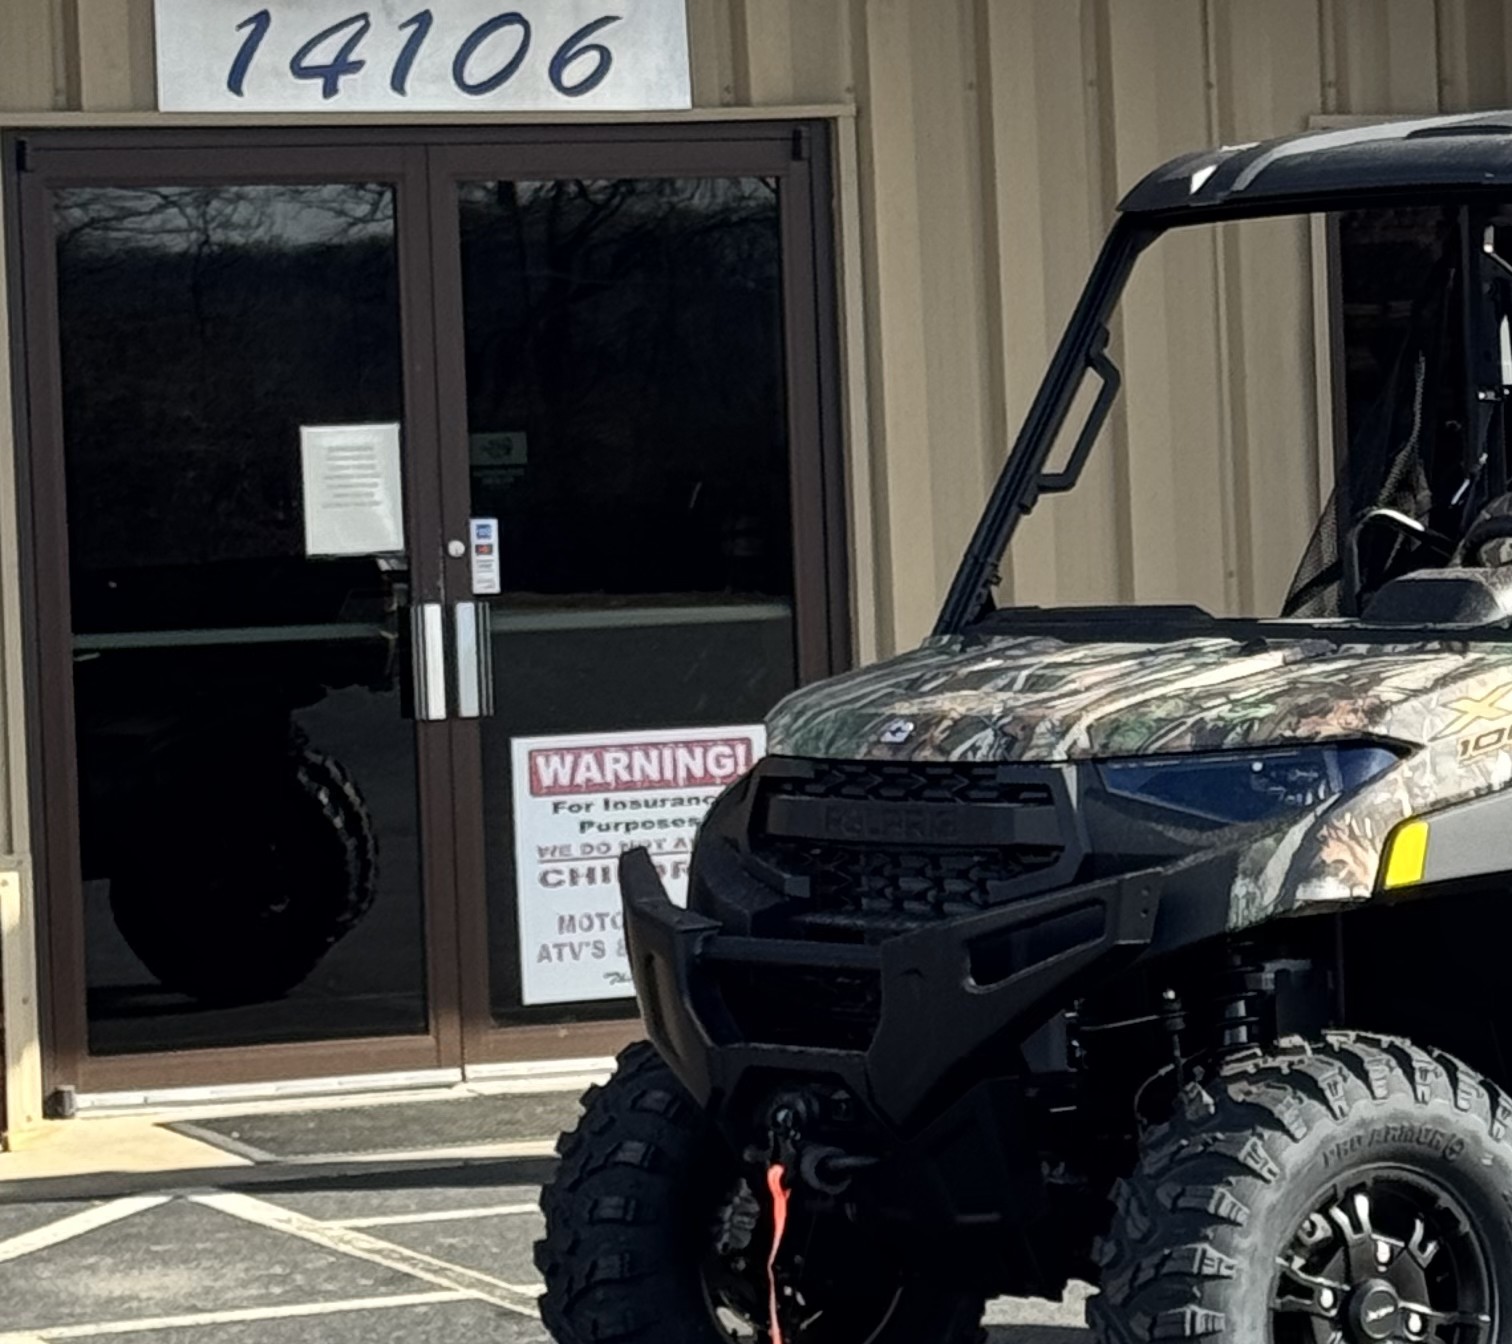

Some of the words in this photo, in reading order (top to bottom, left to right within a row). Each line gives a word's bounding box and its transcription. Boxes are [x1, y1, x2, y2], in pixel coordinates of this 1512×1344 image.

[227, 9, 623, 99] 14106
[536, 743, 747, 788] WARNING!
[552, 800, 595, 814] For
[603, 795, 717, 812] Insuranc
[578, 816, 700, 834] Purposes
[537, 844, 572, 857] WE
[580, 842, 611, 855] DO
[537, 940, 606, 963] ATV'S
